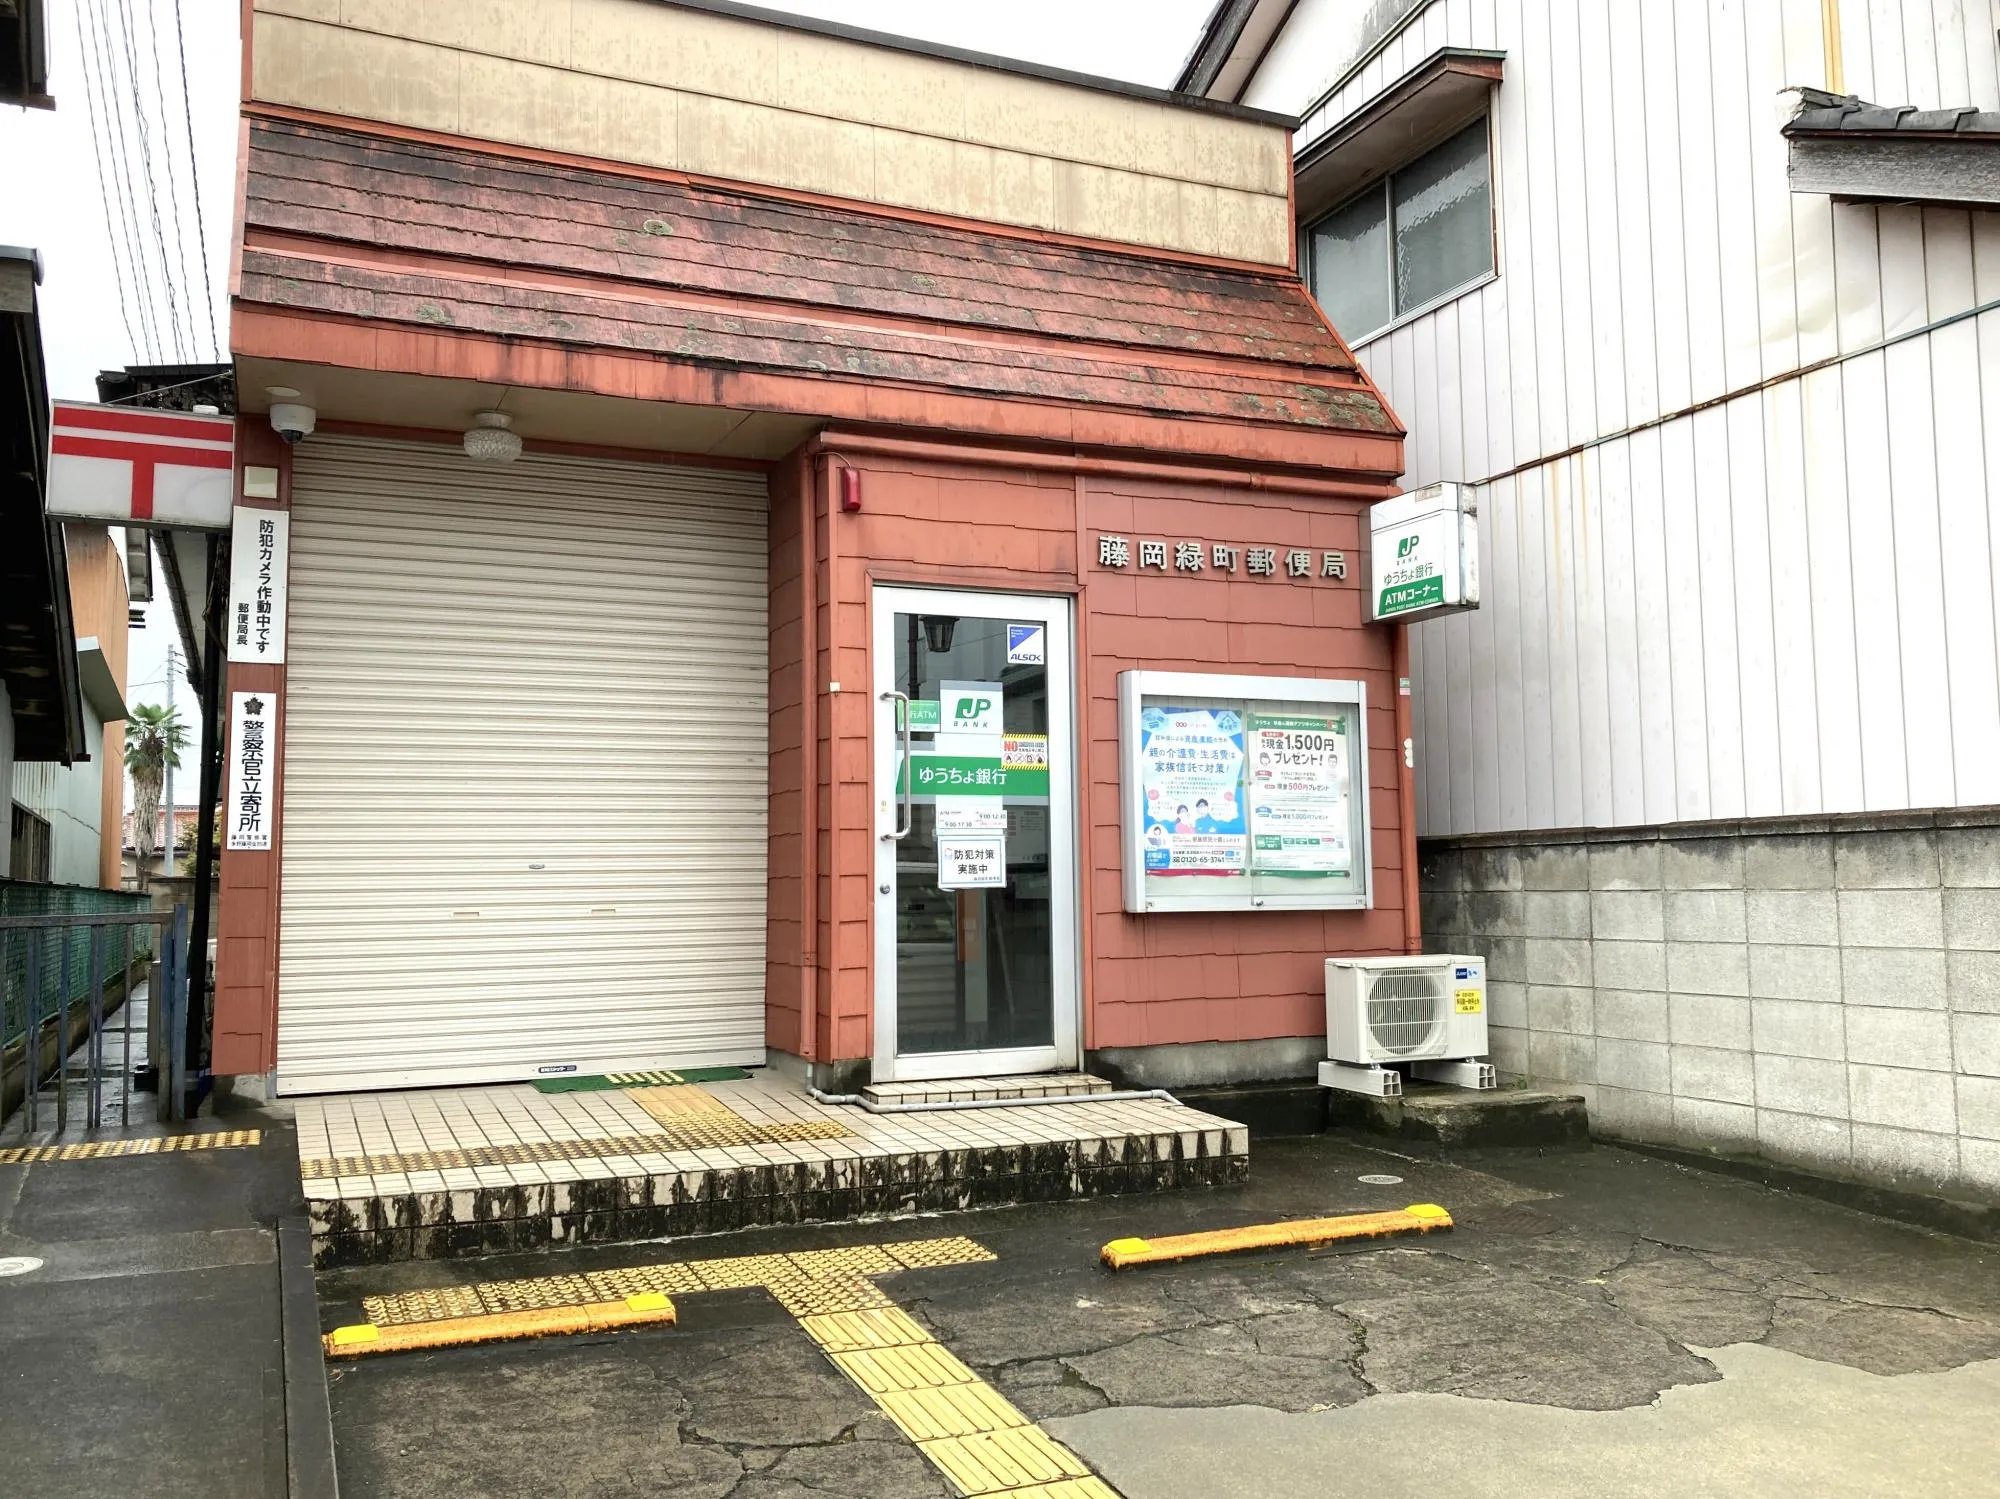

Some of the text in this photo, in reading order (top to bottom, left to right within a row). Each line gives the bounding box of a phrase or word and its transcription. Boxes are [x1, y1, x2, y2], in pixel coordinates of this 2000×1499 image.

[1098, 535, 1348, 580] 藤岡緑町郵便局
[1396, 556, 1418, 566] BANK
[1384, 562, 1433, 586] ゆうちょ銀行
[256, 519, 274, 653] 防犯カメラ作動中です
[1385, 584, 1439, 606] ATMコーナー
[236, 602, 249, 646] 郵便局長
[1010, 653, 1041, 662] ALSOK
[953, 720, 989, 729] BANK
[1004, 741, 1019, 752] NO
[238, 720, 264, 832] 警察官立寄所
[919, 767, 1008, 785] ゆうちょ銀行
[954, 849, 995, 860] 防犯対策
[957, 864, 988, 875] 実施中
